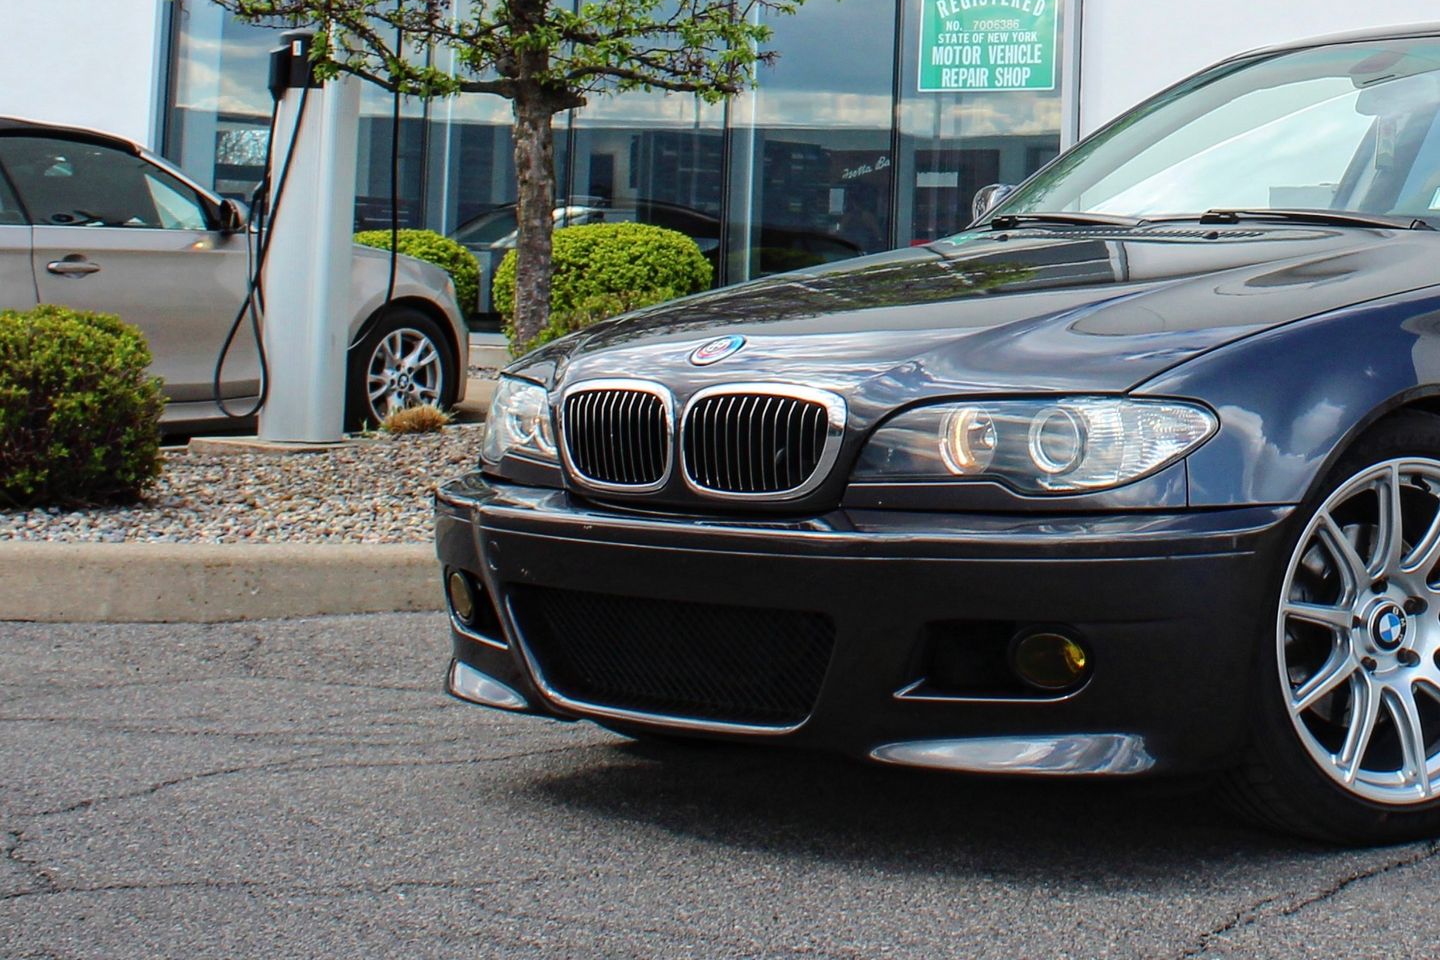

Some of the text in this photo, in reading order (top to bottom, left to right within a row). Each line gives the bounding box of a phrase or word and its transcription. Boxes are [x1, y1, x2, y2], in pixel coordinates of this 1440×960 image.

[946, 20, 963, 31] NO.
[938, 31, 1038, 44] STATE OF NEW YORK
[931, 43, 1043, 66] MOTOR VEHICLE
[941, 66, 1031, 88] REPAIR SHOP
